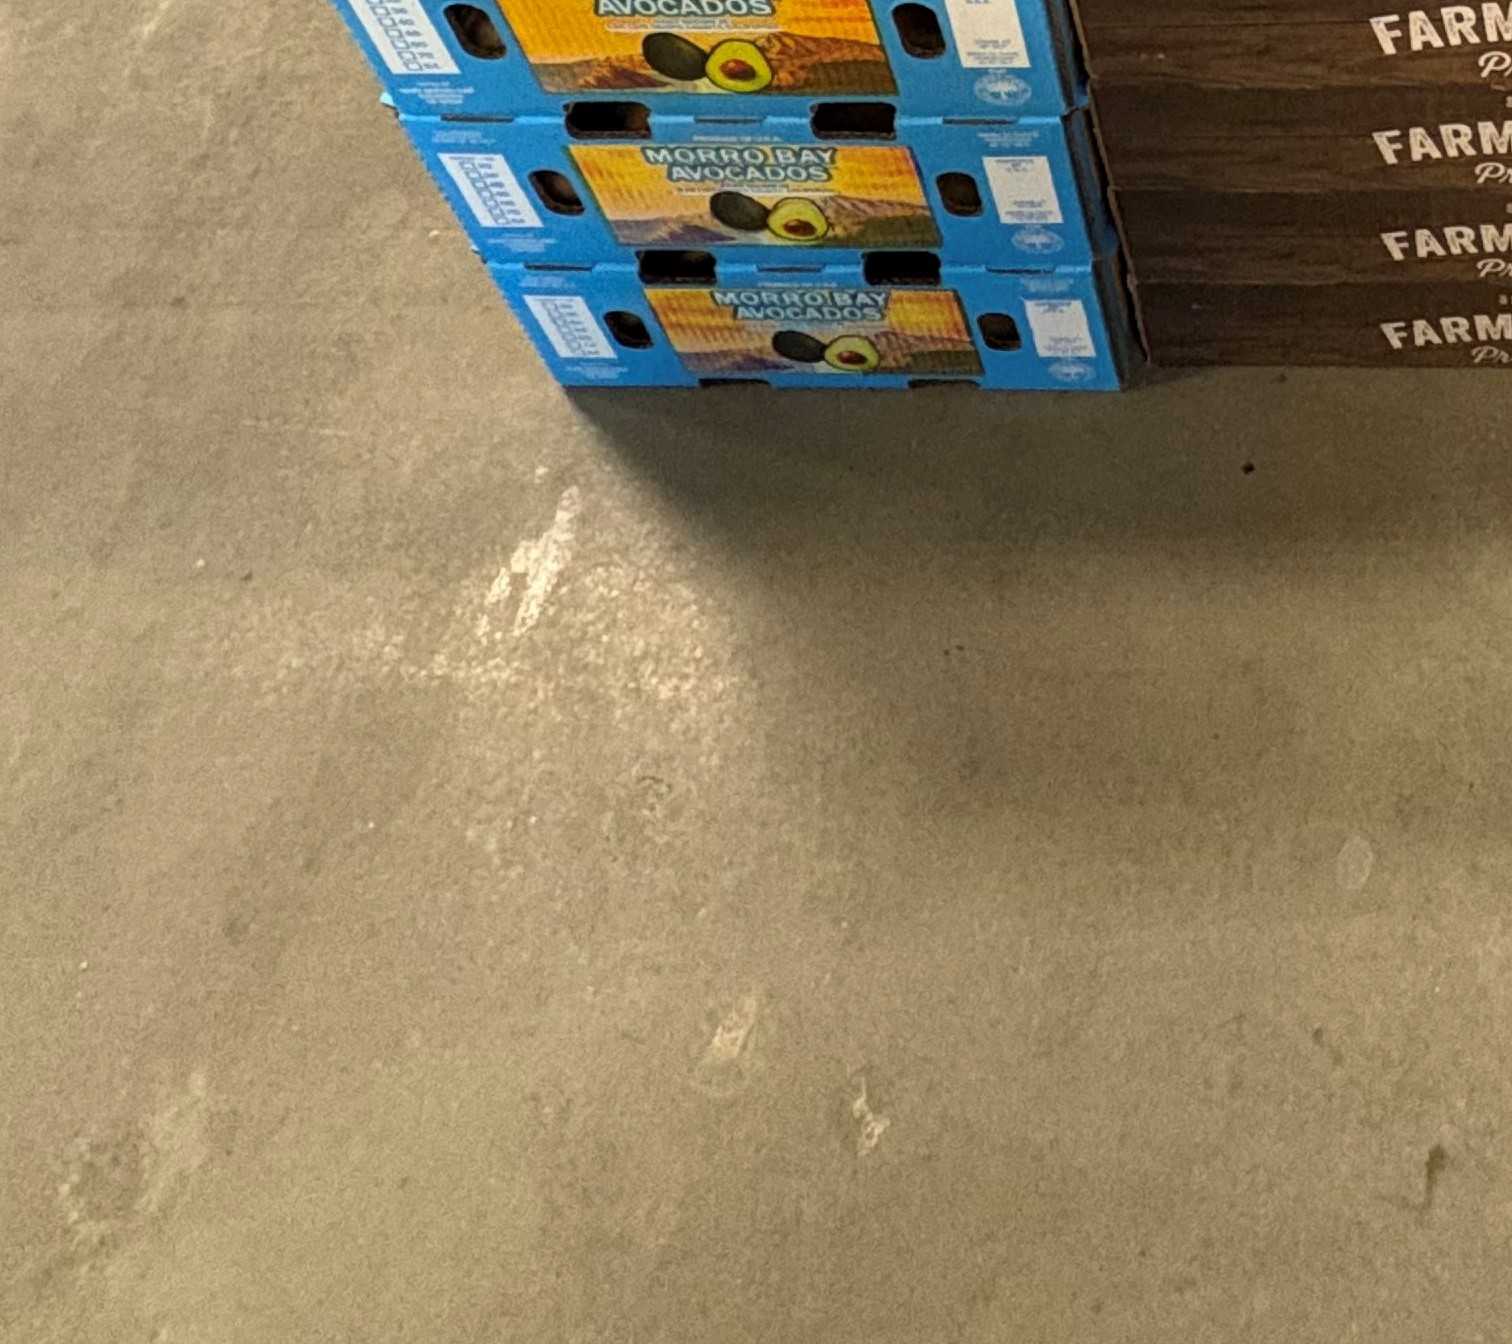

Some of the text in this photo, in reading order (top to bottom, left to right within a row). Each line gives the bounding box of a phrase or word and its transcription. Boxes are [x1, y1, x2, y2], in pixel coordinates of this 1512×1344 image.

[643, 147, 839, 166] MORRO BAY
[668, 165, 829, 184] AVOCADOS
[714, 289, 892, 308] MORRO BAY
[734, 306, 885, 323] AVOCADOS
